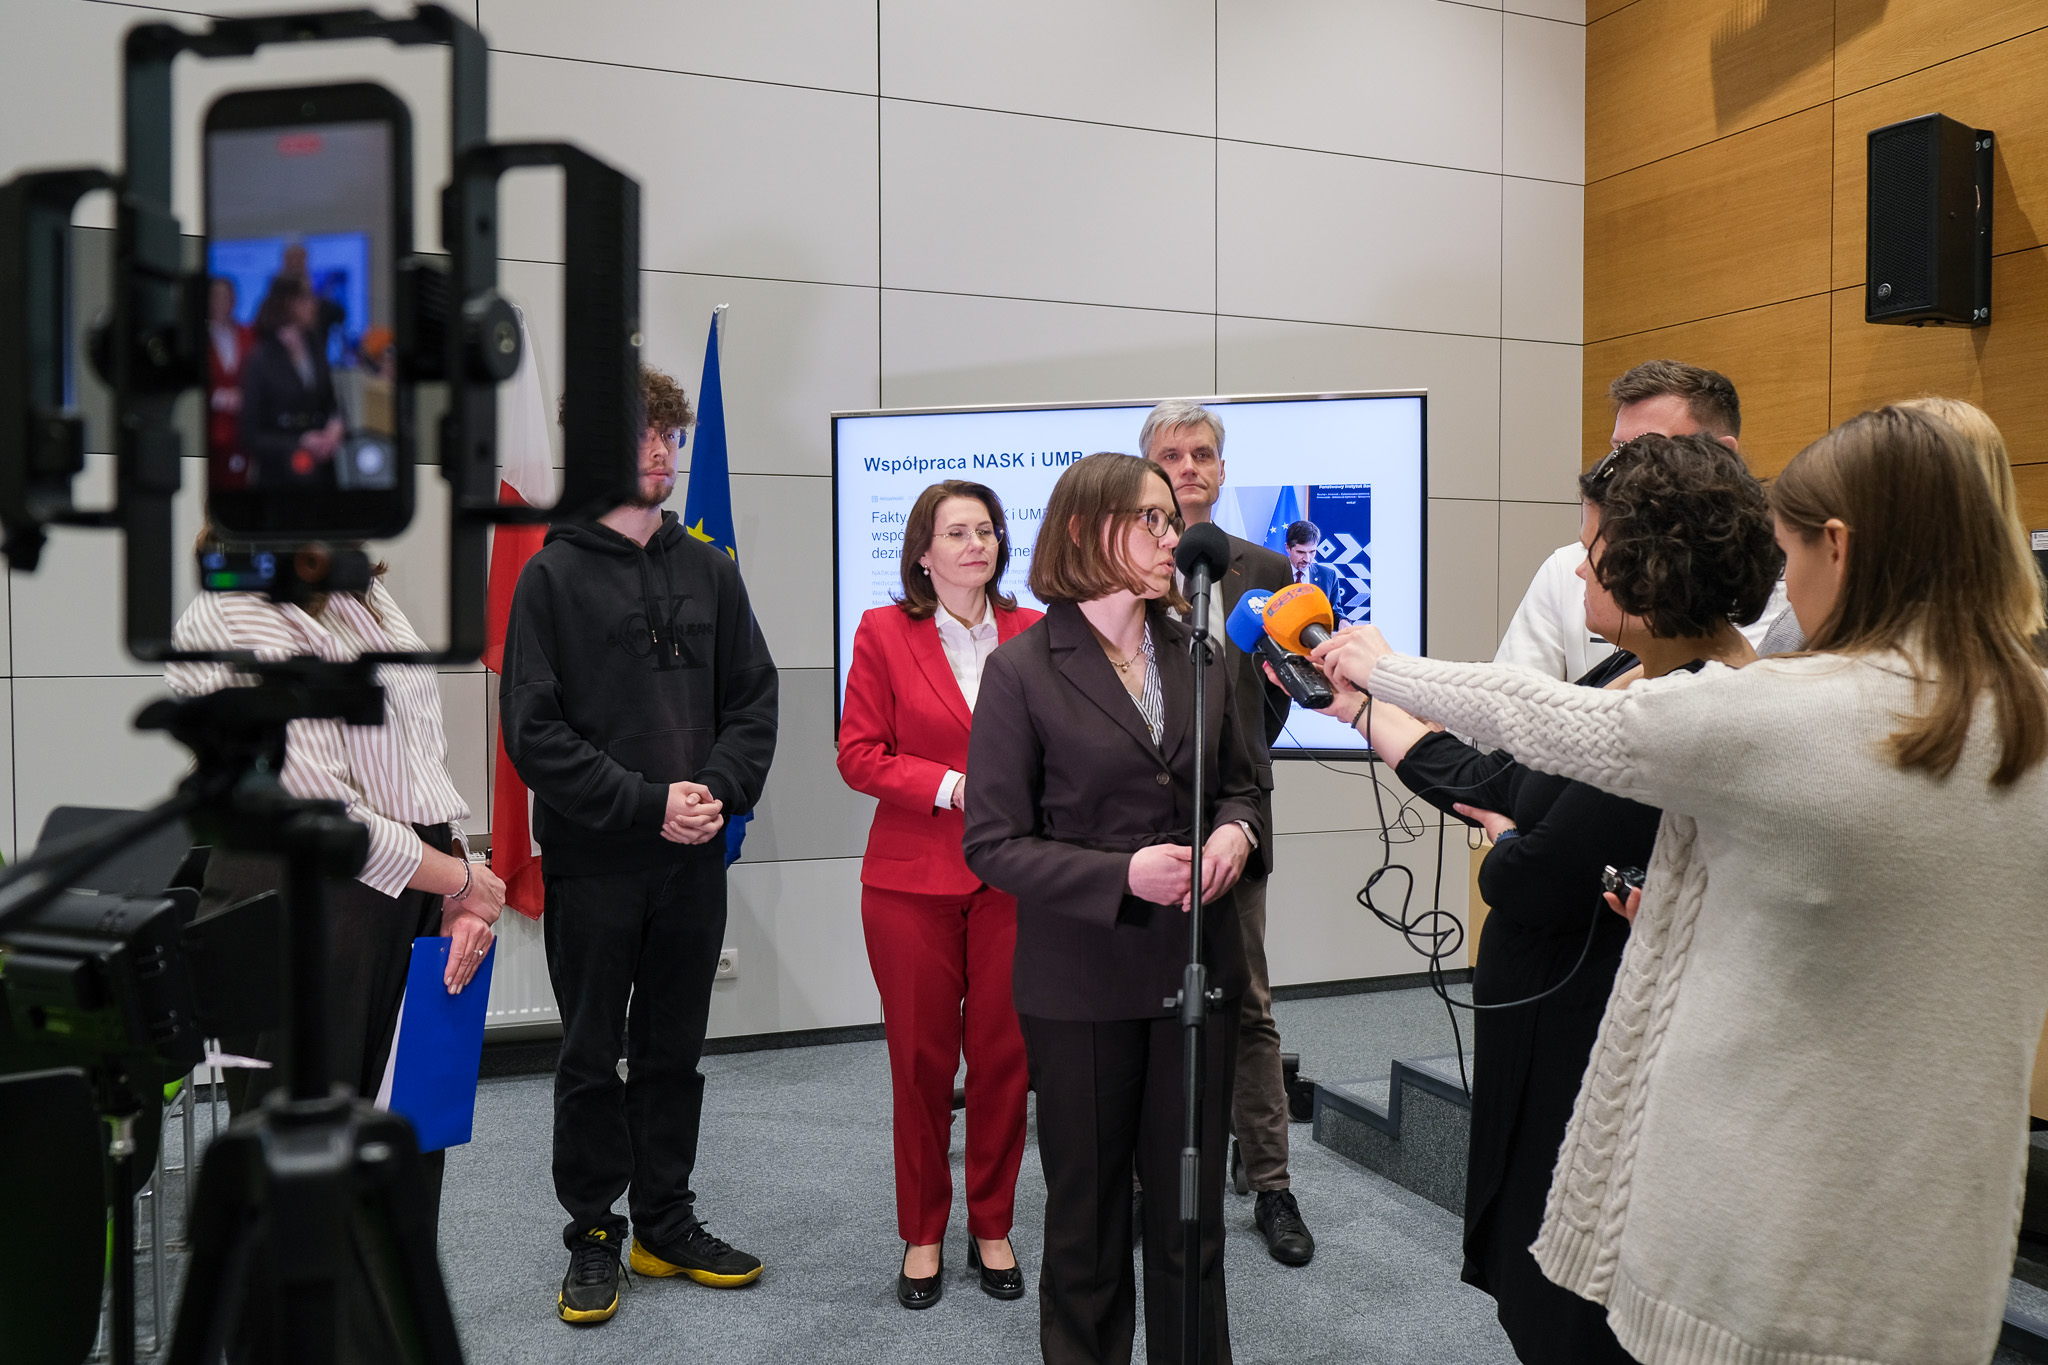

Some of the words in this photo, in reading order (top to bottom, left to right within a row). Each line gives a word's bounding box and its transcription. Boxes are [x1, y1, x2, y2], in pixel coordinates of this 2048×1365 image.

[864, 455, 967, 475] Współpraca
[973, 452, 1025, 469] NASK
[1030, 452, 1035, 467] i
